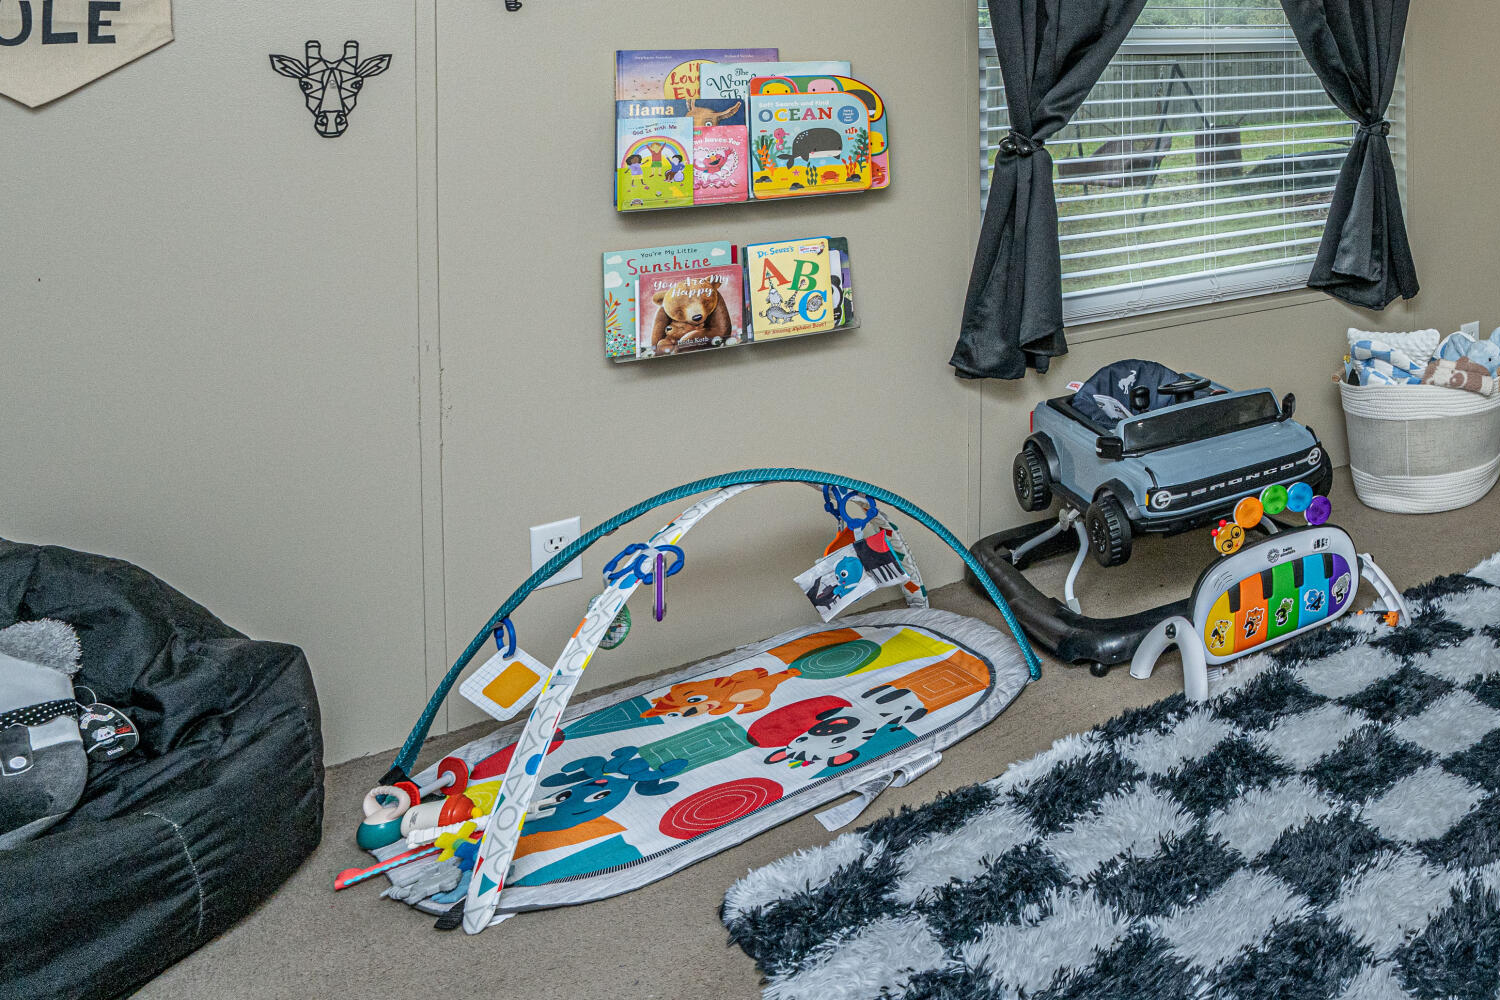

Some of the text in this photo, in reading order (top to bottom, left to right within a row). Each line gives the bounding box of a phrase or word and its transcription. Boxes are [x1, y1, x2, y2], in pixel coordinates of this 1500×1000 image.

[0, 0, 121, 46] ULE
[735, 67, 749, 77] The
[706, 73, 752, 91] Won
[758, 107, 833, 122] OCEAN
[757, 250, 769, 259] Dr.
[626, 255, 711, 276] Sunshine
[653, 274, 729, 291] You Are My
[671, 287, 713, 299] Happy
[1191, 462, 1294, 497] BRONCO
[1310, 592, 1324, 611] 4
[1335, 587, 1345, 603] 5
[1275, 607, 1288, 626] 3
[1244, 620, 1256, 638] 2
